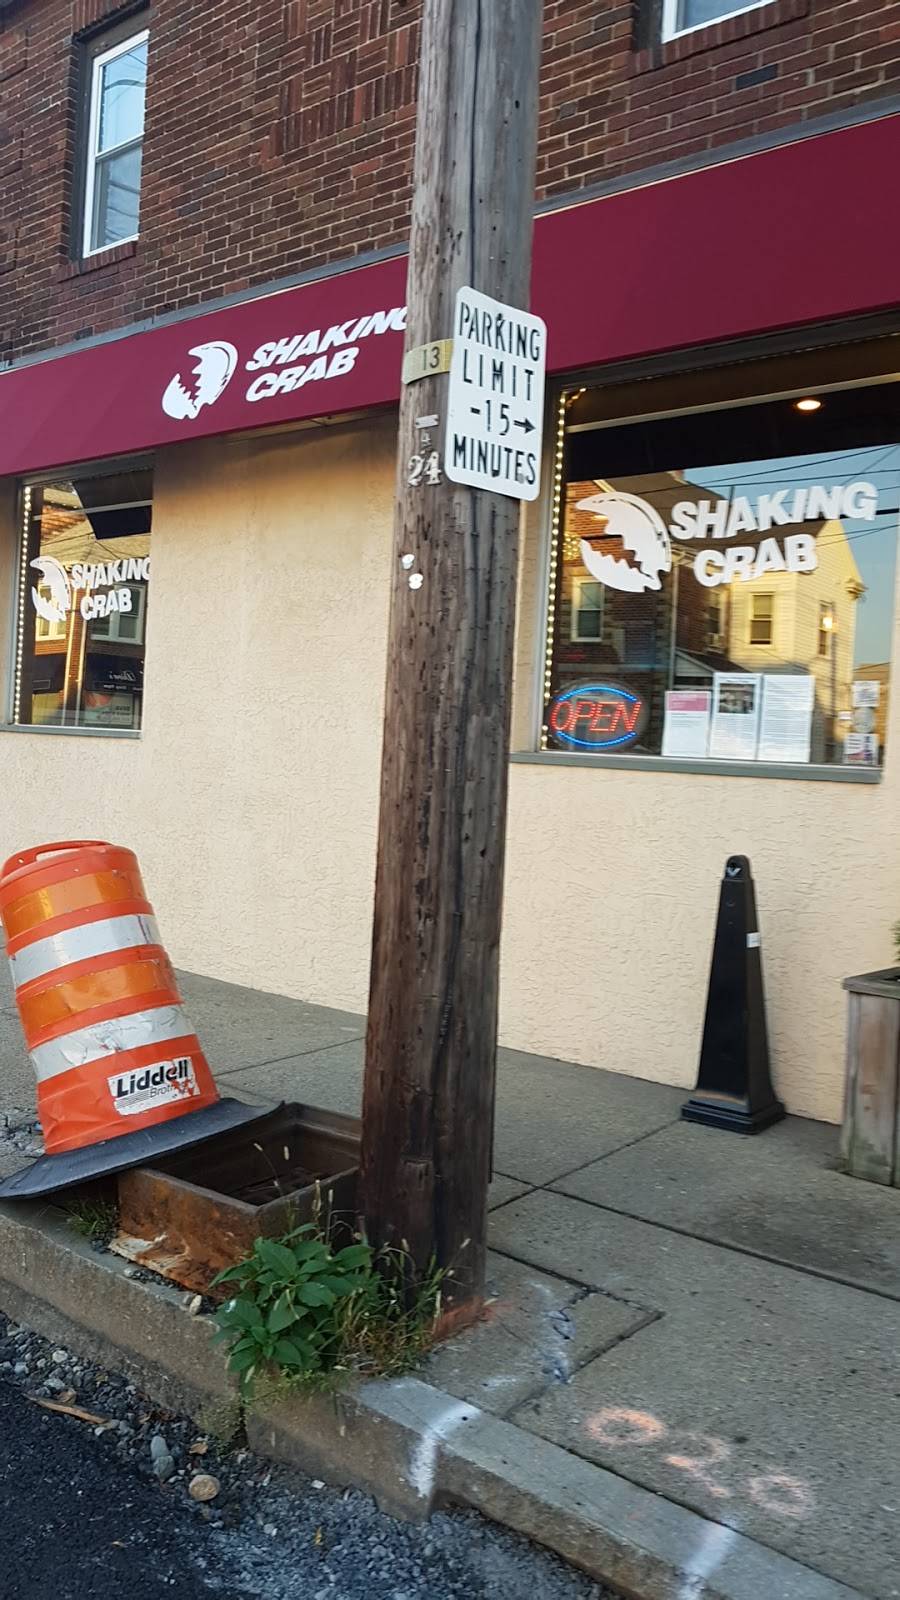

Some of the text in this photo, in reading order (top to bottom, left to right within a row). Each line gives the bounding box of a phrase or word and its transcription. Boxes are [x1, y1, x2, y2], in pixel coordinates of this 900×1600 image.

[459, 302, 541, 361] PARKING
[245, 347, 360, 402] CRAB
[422, 346, 440, 371] 13
[463, 349, 534, 400] LIMIT
[407, 451, 442, 487] 24
[453, 433, 537, 485] MINUTES
[668, 481, 878, 540] SHAKING
[693, 533, 818, 588] CRAB
[80, 588, 132, 620] CRAB
[551, 701, 642, 731] OPEN
[117, 1059, 187, 1098] Liddell
